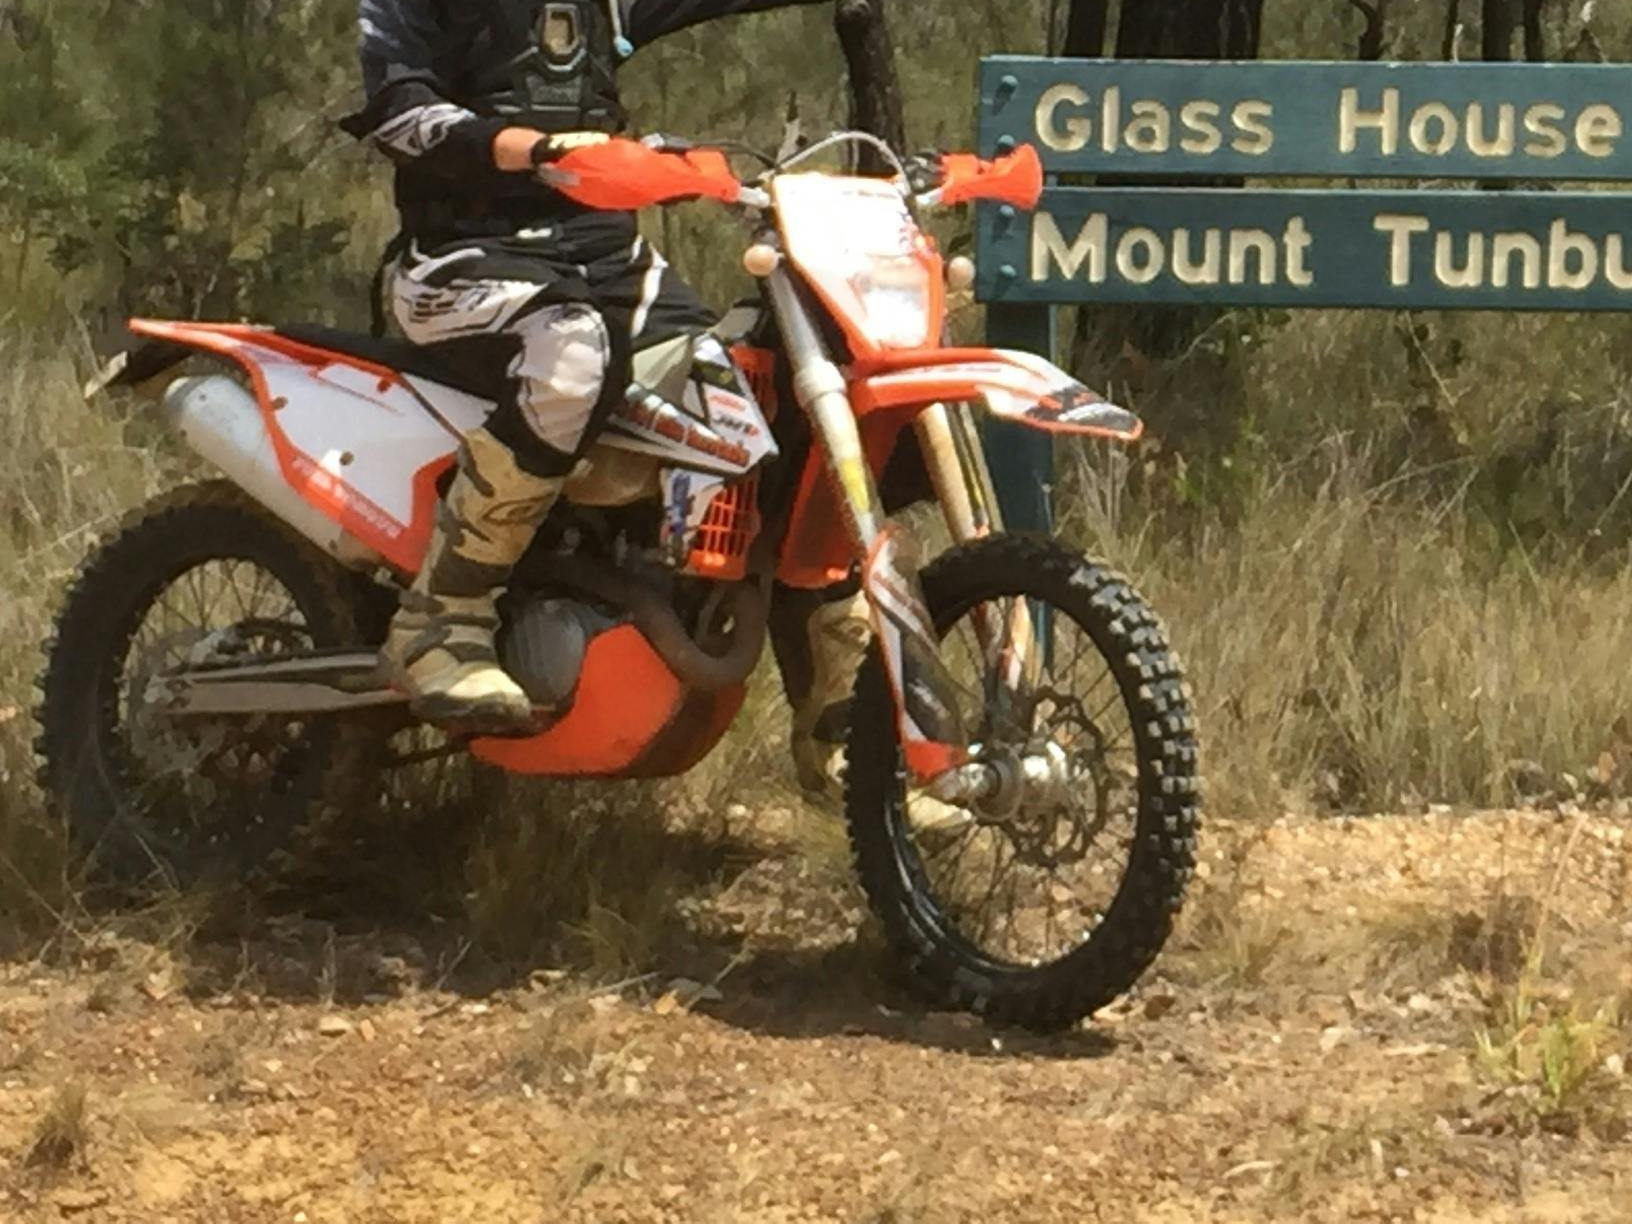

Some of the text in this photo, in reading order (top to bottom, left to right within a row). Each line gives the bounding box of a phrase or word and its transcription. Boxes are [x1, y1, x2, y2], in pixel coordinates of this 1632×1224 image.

[1033, 84, 1275, 157] Glass
[1337, 86, 1623, 160] House
[1029, 211, 1314, 287] Mount
